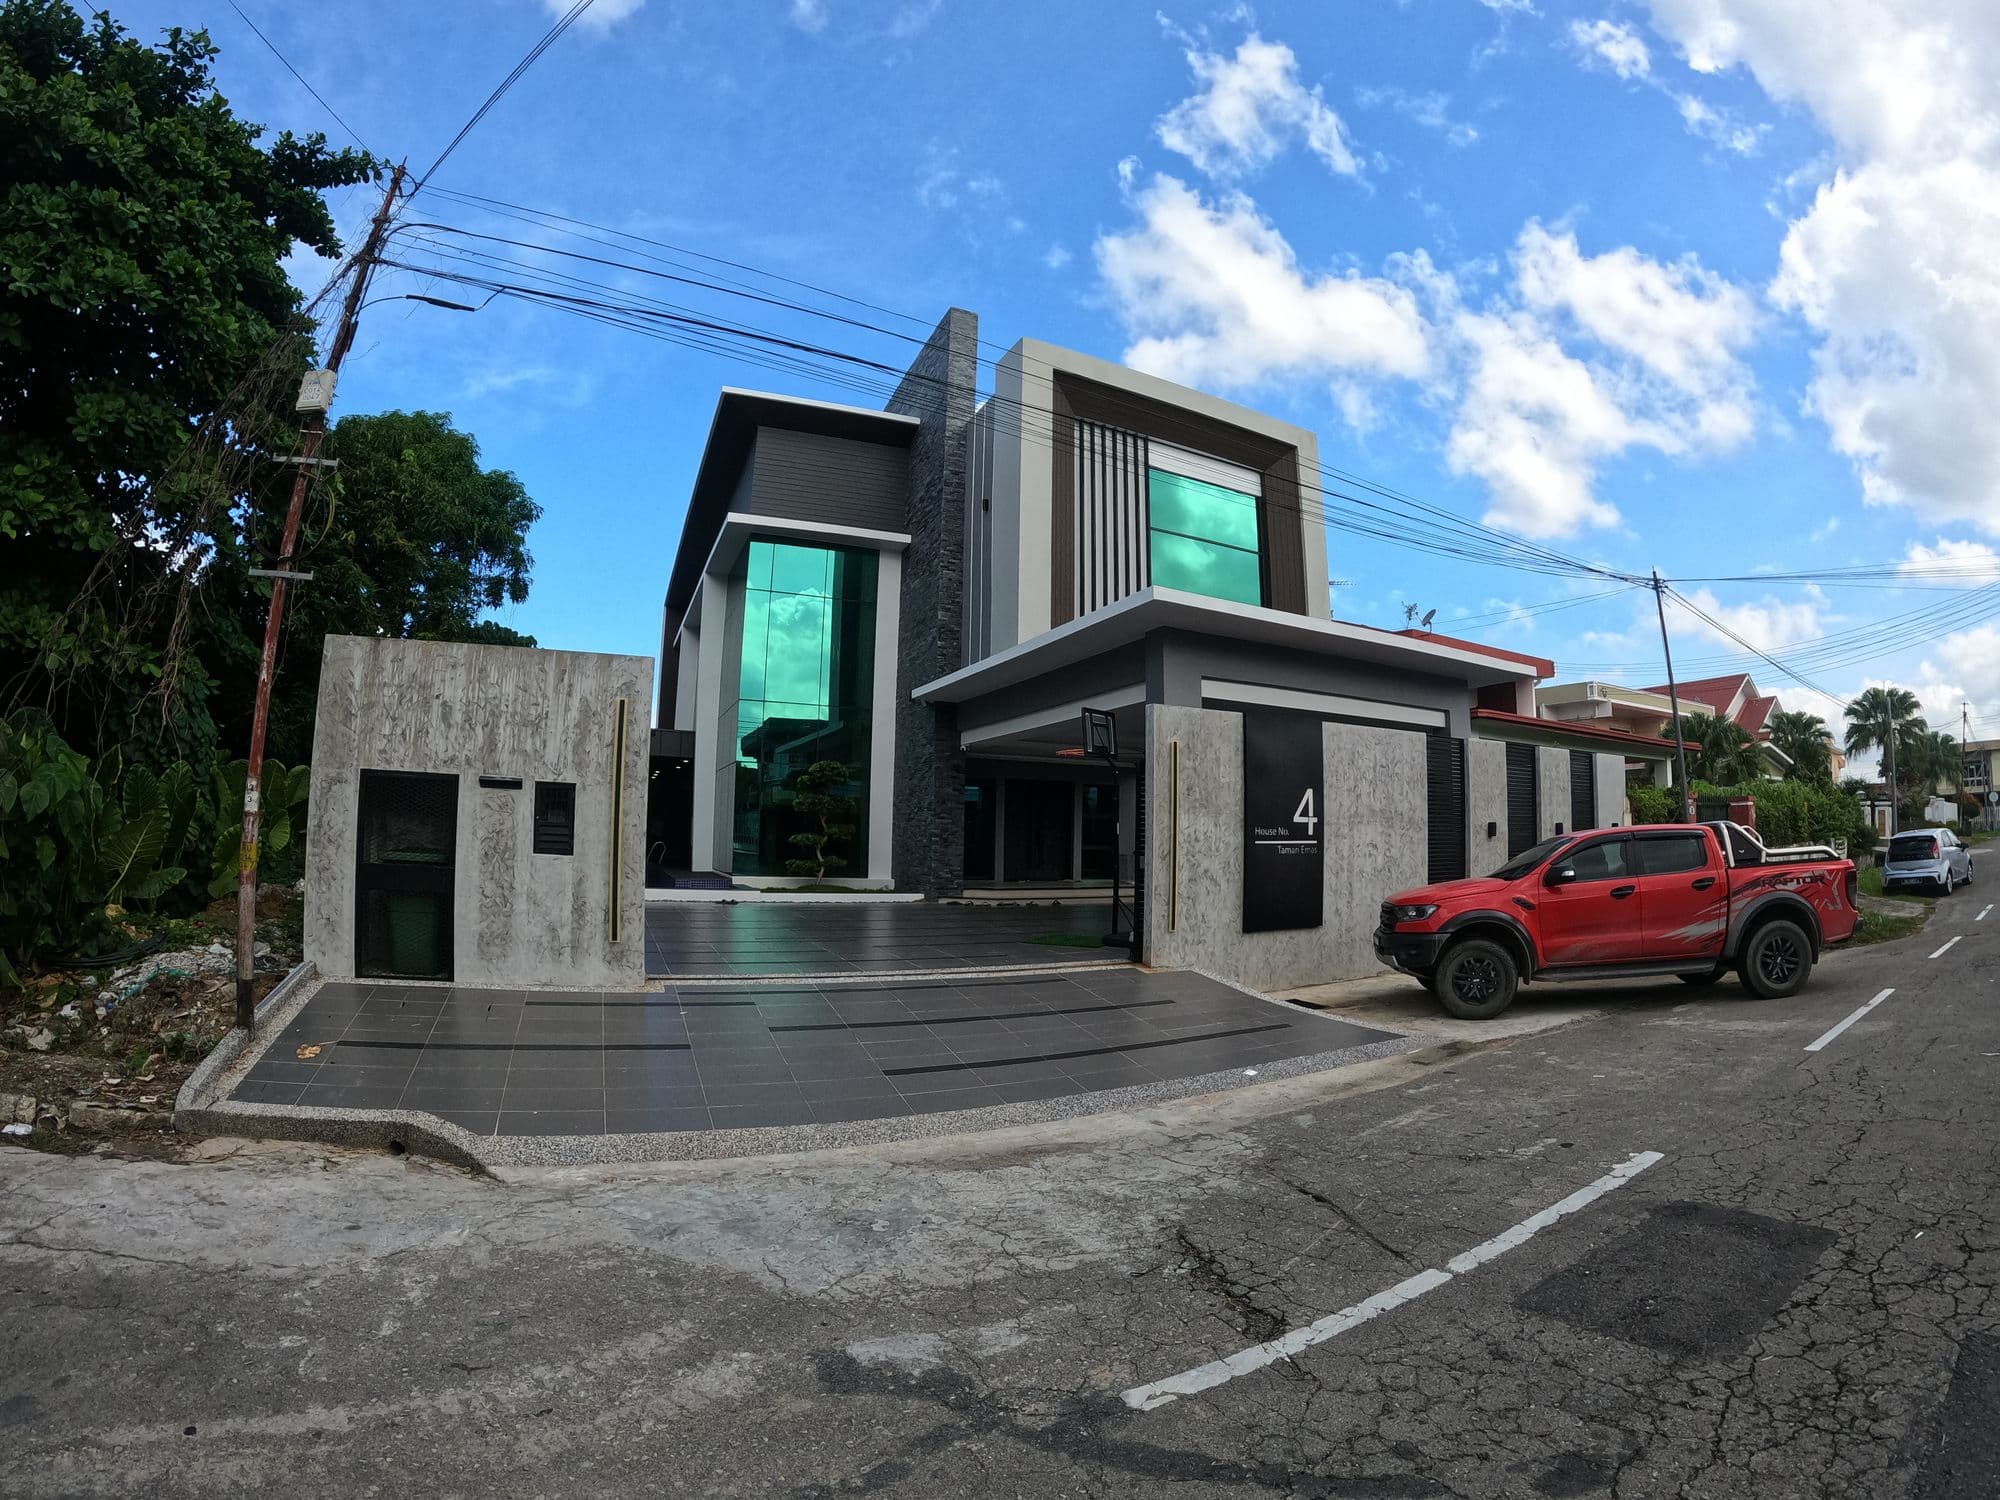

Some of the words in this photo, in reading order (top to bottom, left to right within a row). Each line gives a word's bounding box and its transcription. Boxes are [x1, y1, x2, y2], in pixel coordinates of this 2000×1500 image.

[1254, 827, 1277, 836] House
[1278, 827, 1290, 836] No.
[1293, 787, 1318, 836] 4
[1278, 845, 1299, 854] Taman
[1761, 875, 1825, 889] RAPTOR
